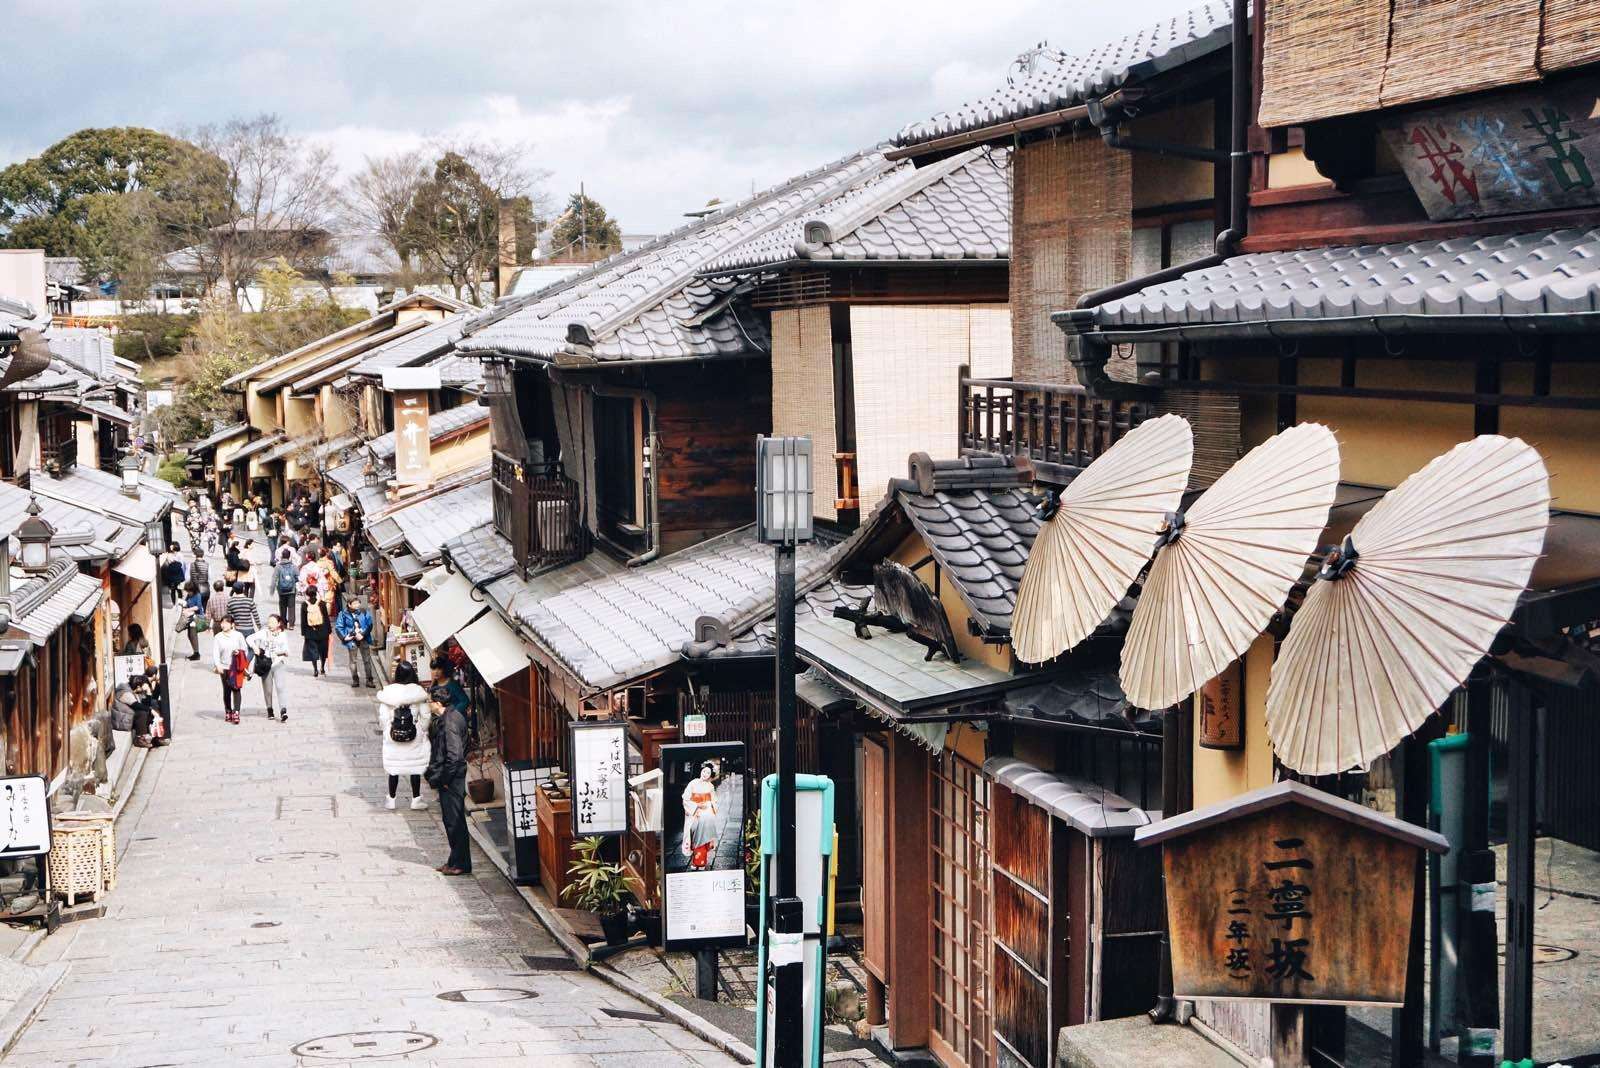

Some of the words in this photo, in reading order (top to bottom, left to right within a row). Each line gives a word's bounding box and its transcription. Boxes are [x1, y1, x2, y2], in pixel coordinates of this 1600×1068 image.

[517, 793, 534, 830] ふたば
[579, 781, 596, 824] ふたば
[1264, 837, 1314, 981] 二寧坂
